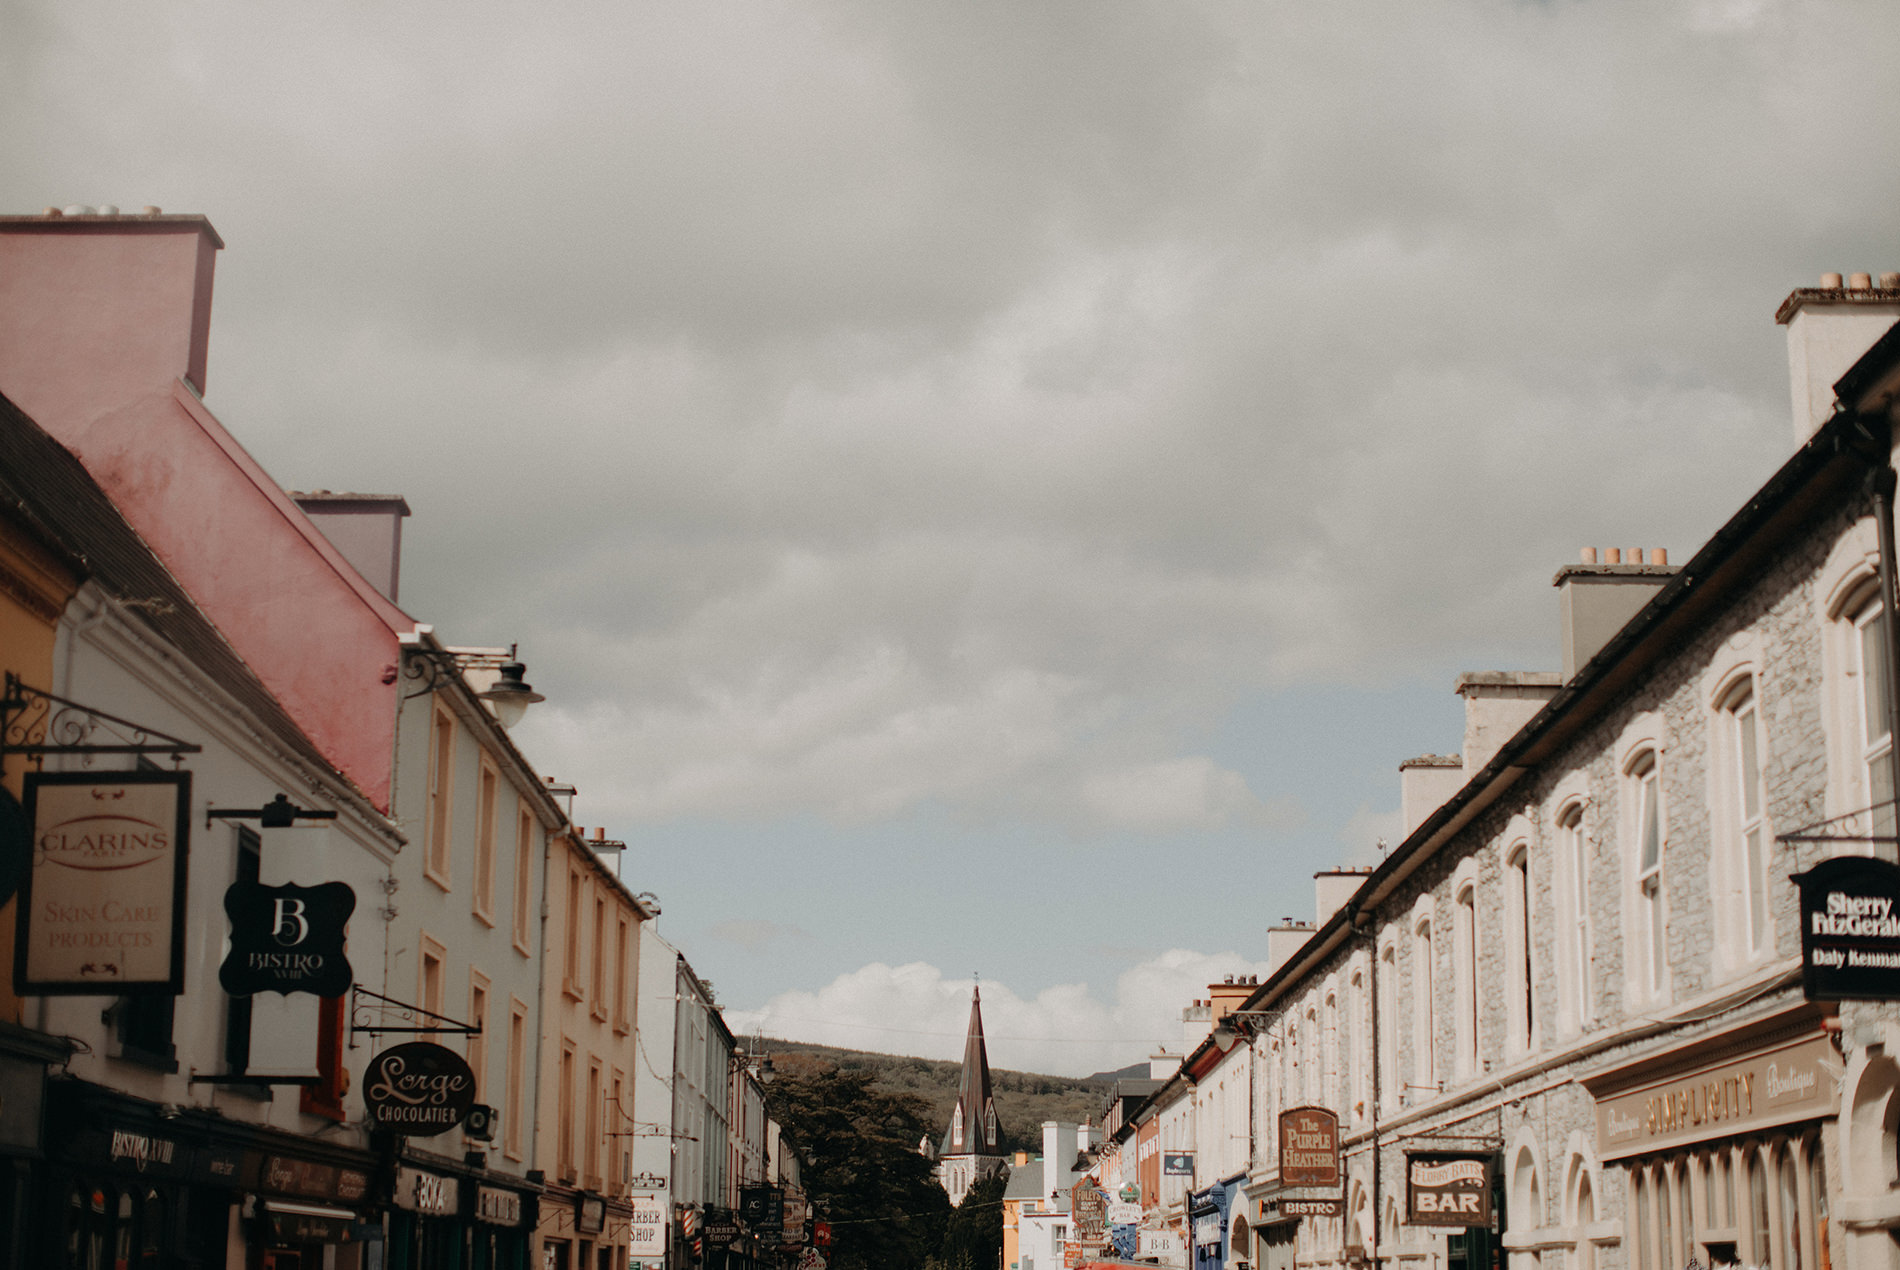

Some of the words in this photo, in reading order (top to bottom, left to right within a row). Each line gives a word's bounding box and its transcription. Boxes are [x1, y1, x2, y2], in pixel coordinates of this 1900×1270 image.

[39, 832, 169, 851] CLARINS
[1827, 891, 1894, 921] Sherry
[271, 898, 309, 947] B
[1811, 911, 1900, 937] FitzGeral
[48, 931, 153, 948] PRODUCTS
[248, 952, 324, 977] BISTRO
[1812, 948, 1846, 970] Daly
[370, 1056, 470, 1105] Lorge
[1647, 1072, 1754, 1136] SIMPLICITY
[1767, 1062, 1816, 1098] Boutique
[377, 1104, 457, 1123] CHOCOLATIER
[1300, 1118, 1319, 1132] The
[1287, 1129, 1331, 1149] PURPLE
[110, 1129, 149, 1173] BISTRO
[149, 1138, 175, 1164] XVIII
[1282, 1148, 1336, 1168] HEATHER
[419, 1174, 445, 1210] BOKA
[1285, 1202, 1336, 1214] BISTRO
[1416, 1192, 1480, 1213] BAR
[630, 1227, 655, 1242] SHOP
[705, 1226, 737, 1234] BARBER
[709, 1234, 732, 1242] SHOP
